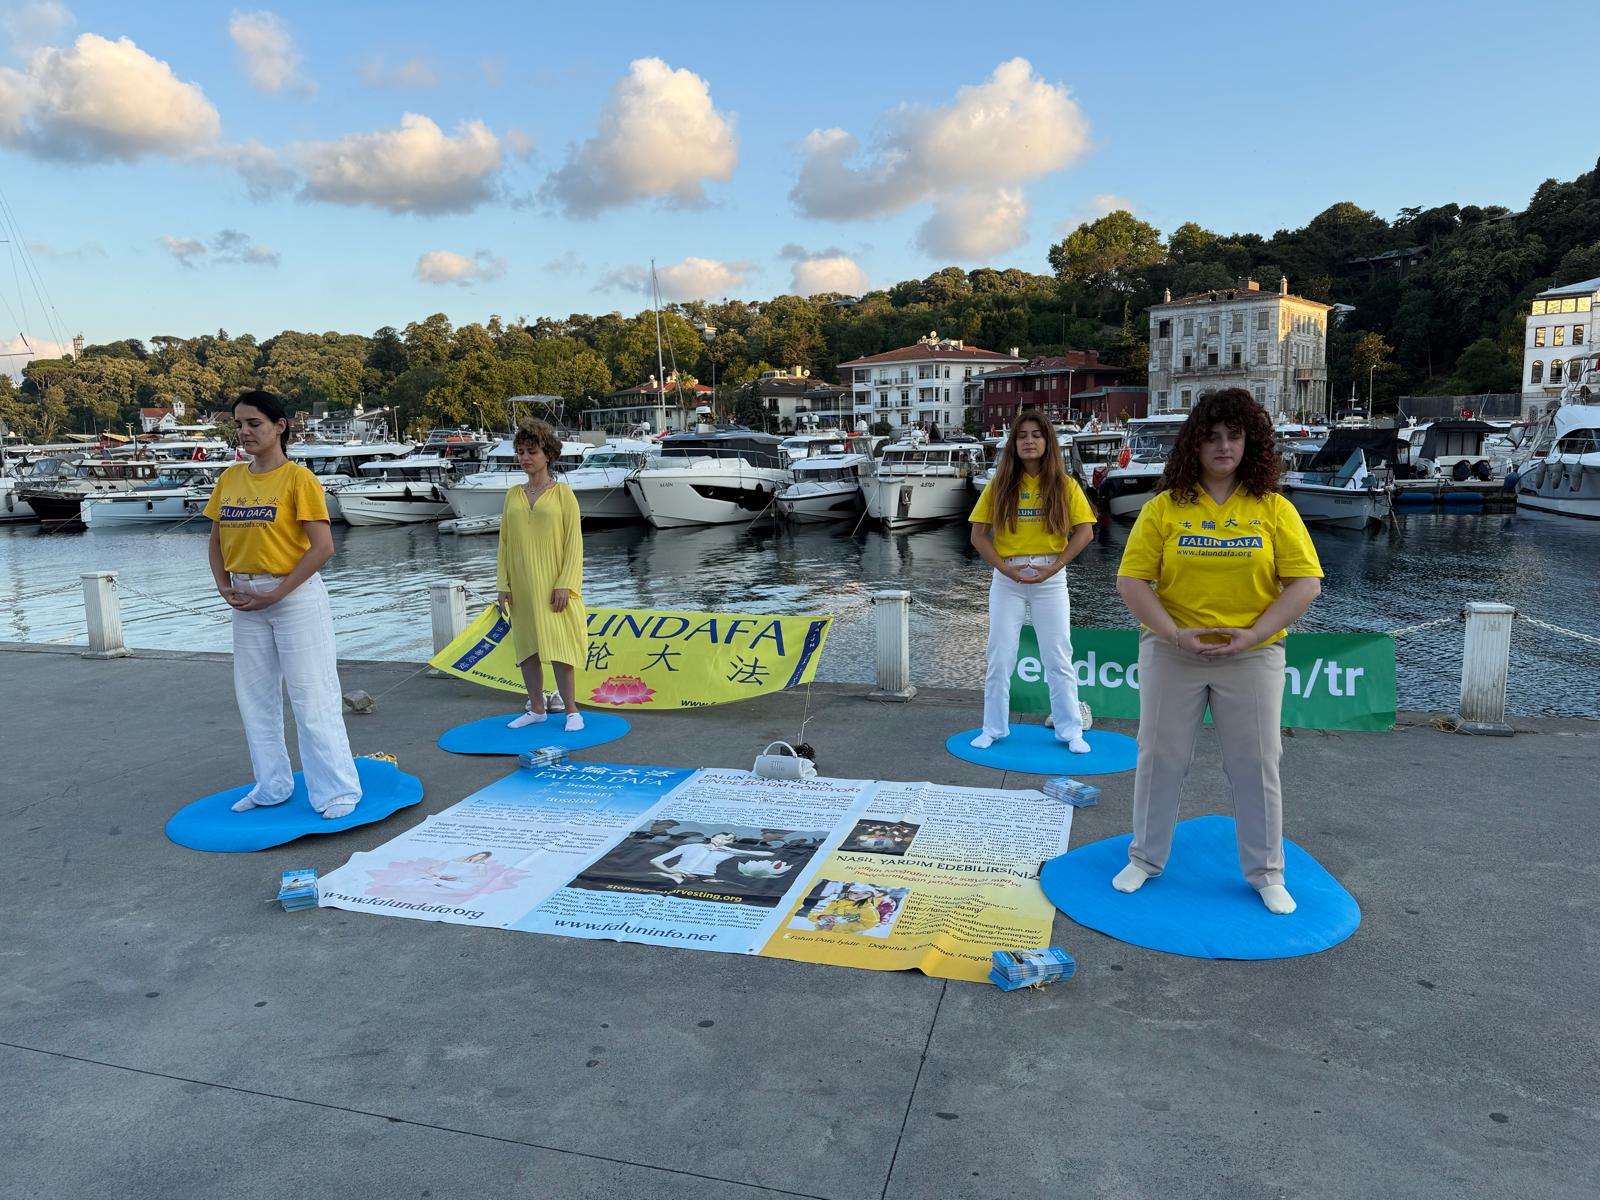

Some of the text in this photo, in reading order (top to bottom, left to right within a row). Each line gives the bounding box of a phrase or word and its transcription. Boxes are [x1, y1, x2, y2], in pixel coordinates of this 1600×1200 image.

[246, 508, 273, 518] DAFA
[1182, 537, 1260, 547] FALUN DAFA
[1176, 549, 1252, 557] www.falundafa.org
[587, 613, 786, 657] UNDAFA
[535, 771, 662, 785] FALUN DAFA
[880, 859, 933, 868] YARDIM
[322, 890, 486, 920] www.falundafa.org
[554, 918, 718, 943] www.faluninfo.net
